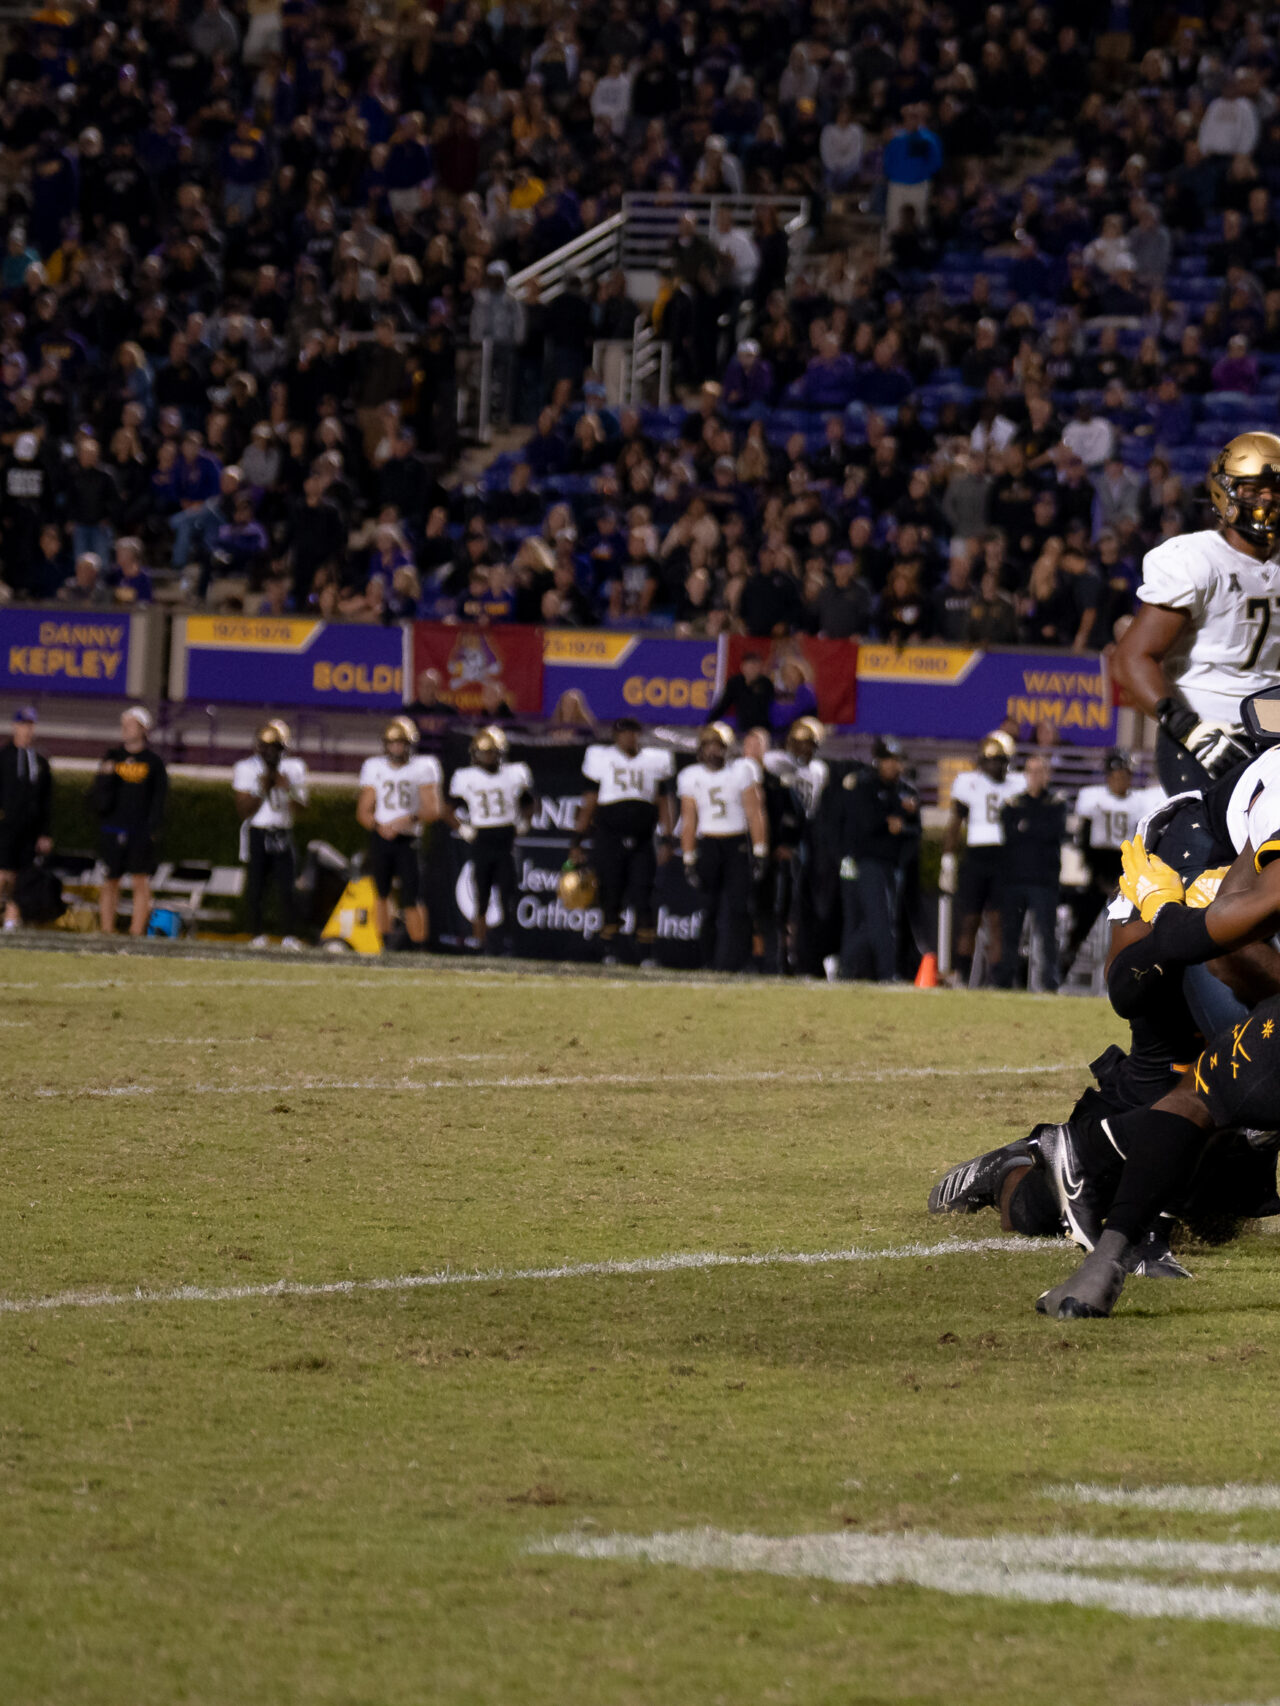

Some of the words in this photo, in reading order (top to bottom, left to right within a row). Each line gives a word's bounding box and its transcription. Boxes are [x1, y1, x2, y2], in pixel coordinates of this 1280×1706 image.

[40, 621, 123, 648] DANNY
[8, 645, 121, 679] KEPLEY
[1023, 670, 1102, 698] WAYNE
[1007, 695, 1111, 729] INMAN
[382, 781, 412, 811] 26
[613, 769, 643, 793] 54
[475, 789, 506, 819] 33
[709, 785, 726, 819] 5
